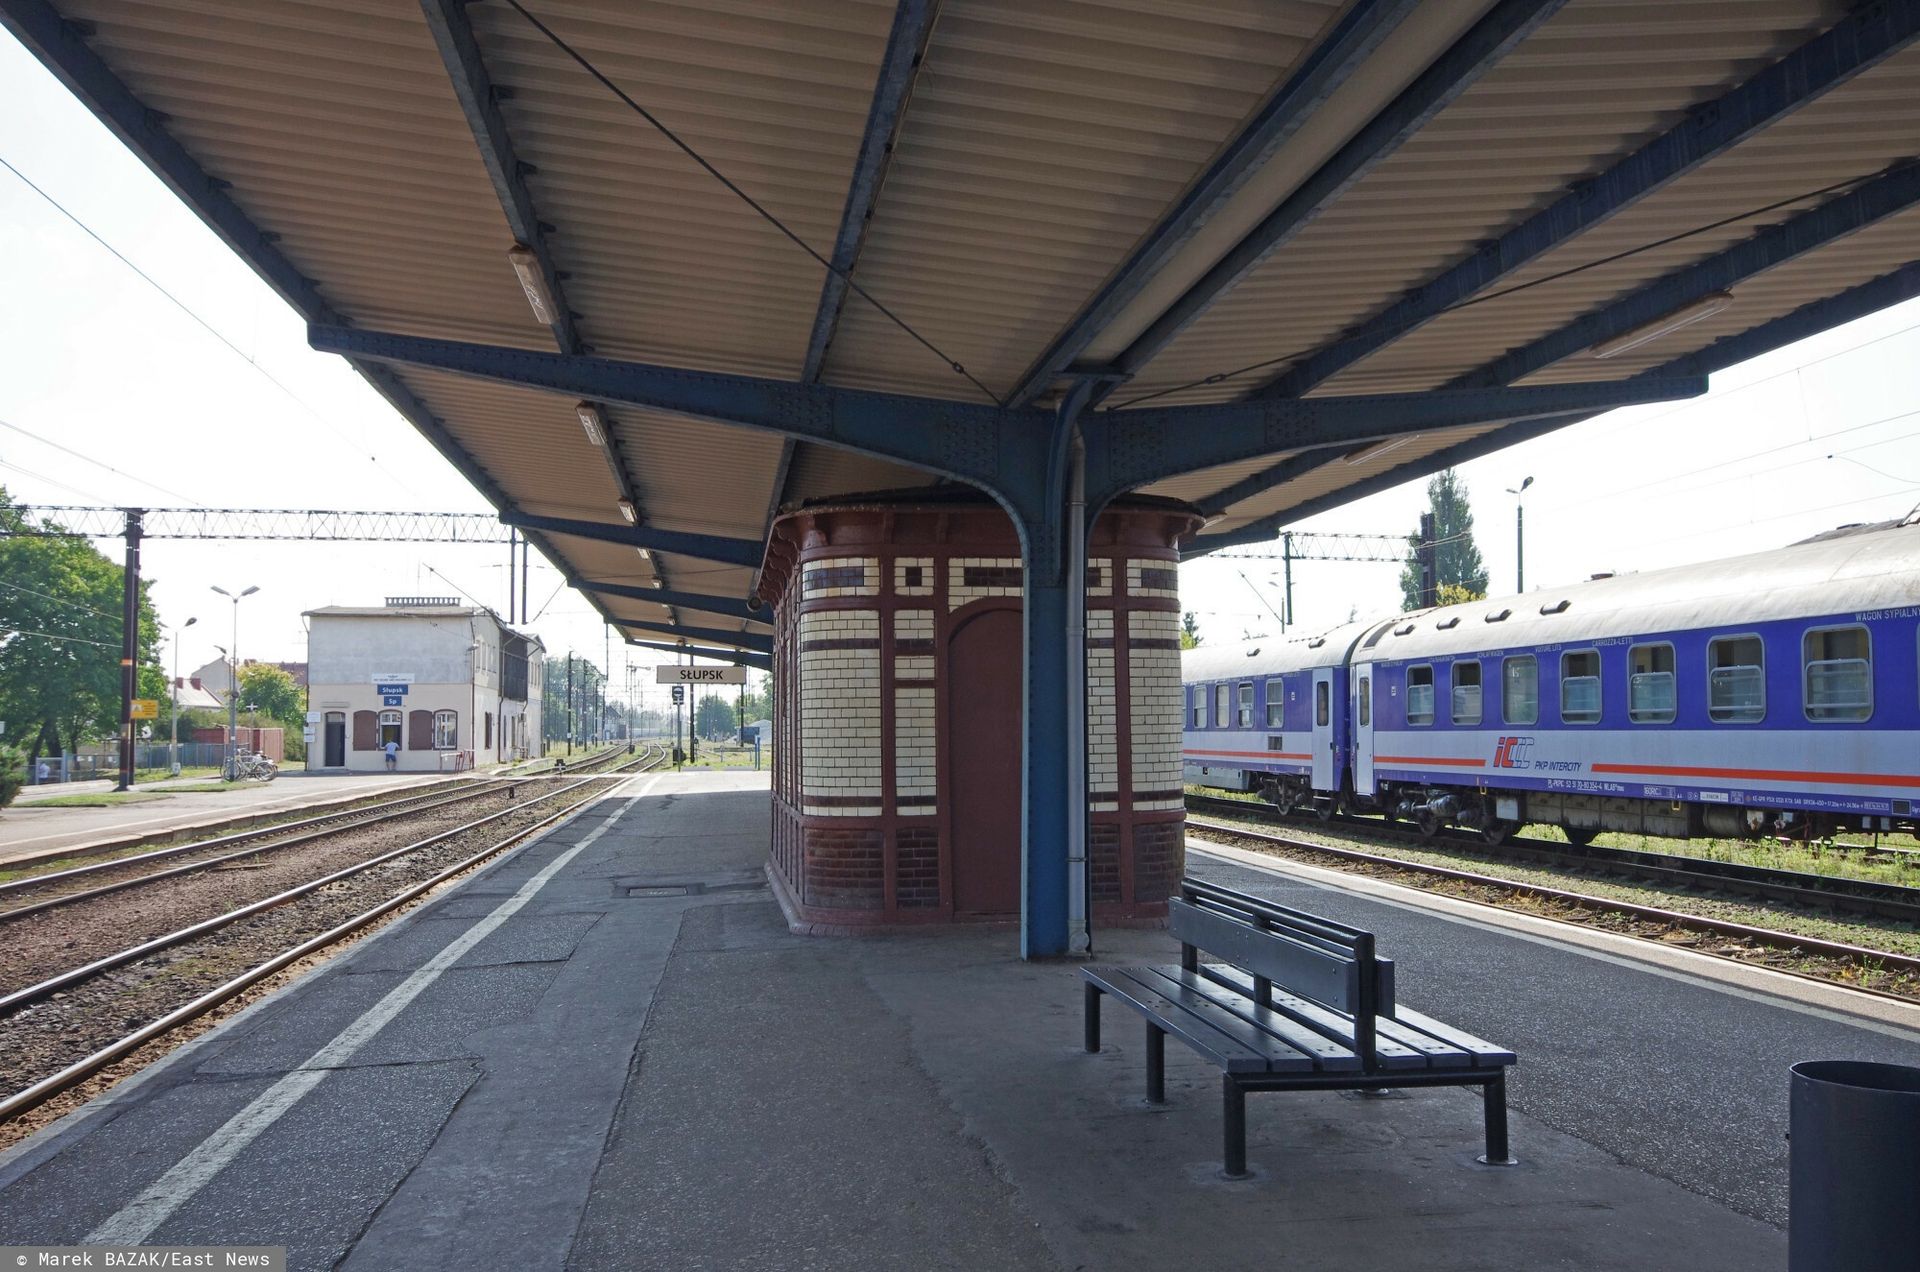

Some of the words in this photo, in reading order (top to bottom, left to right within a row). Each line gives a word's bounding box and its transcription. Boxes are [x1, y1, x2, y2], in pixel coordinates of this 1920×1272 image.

[1855, 611, 1882, 621] WAGON
[680, 670, 723, 680] SŁUPSK
[1534, 760, 1549, 770] PKP
[1549, 761, 1582, 772] INTERCITY
